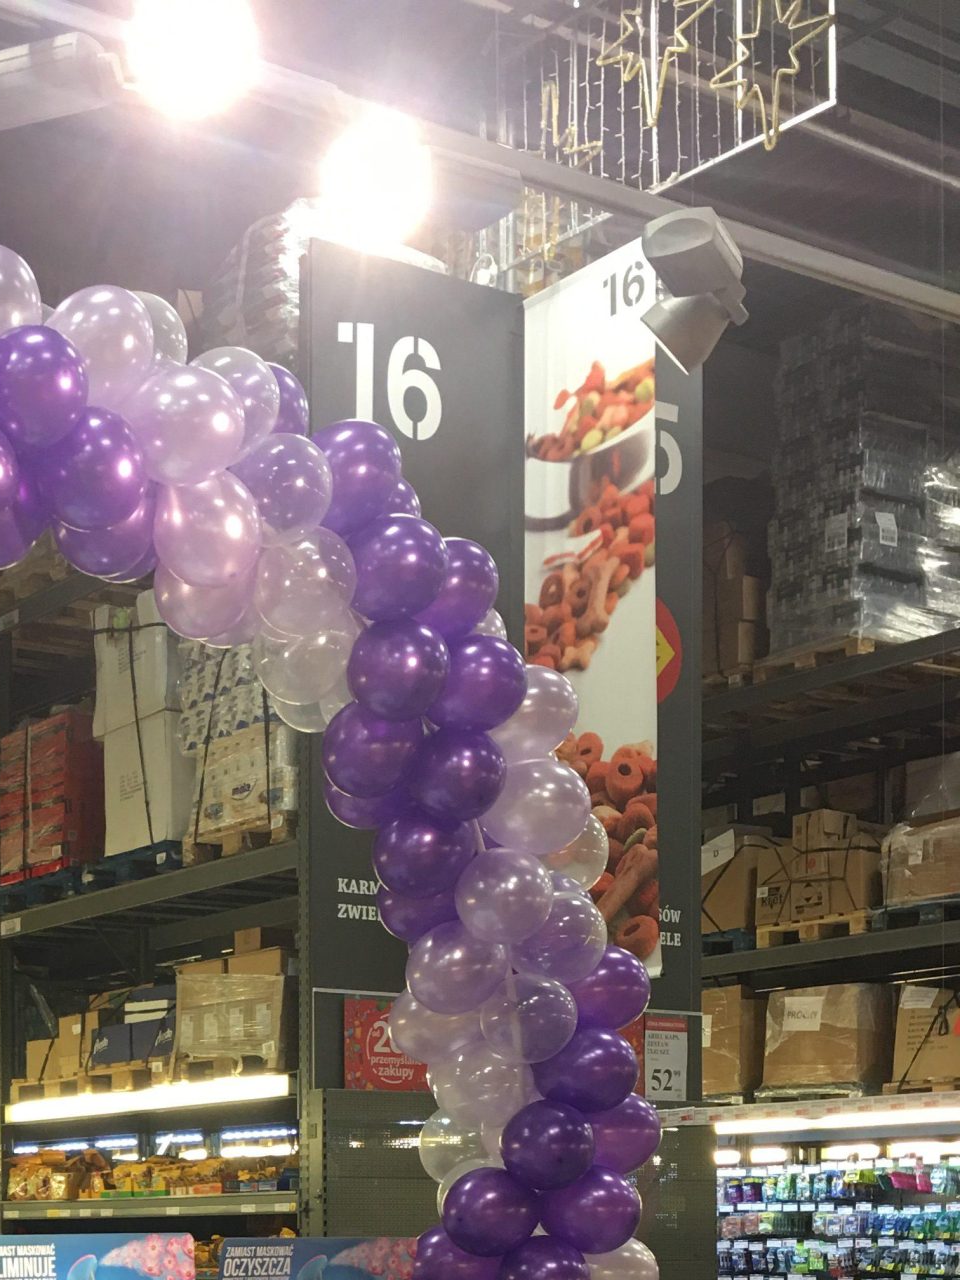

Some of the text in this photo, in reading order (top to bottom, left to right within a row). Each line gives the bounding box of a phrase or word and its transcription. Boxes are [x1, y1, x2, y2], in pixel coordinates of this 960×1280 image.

[602, 261, 646, 317] 16
[337, 322, 442, 441] 16
[378, 1065, 414, 1080] zakupy
[651, 1069, 672, 1091] 52
[223, 1257, 290, 1276] OCZYSZCZA
